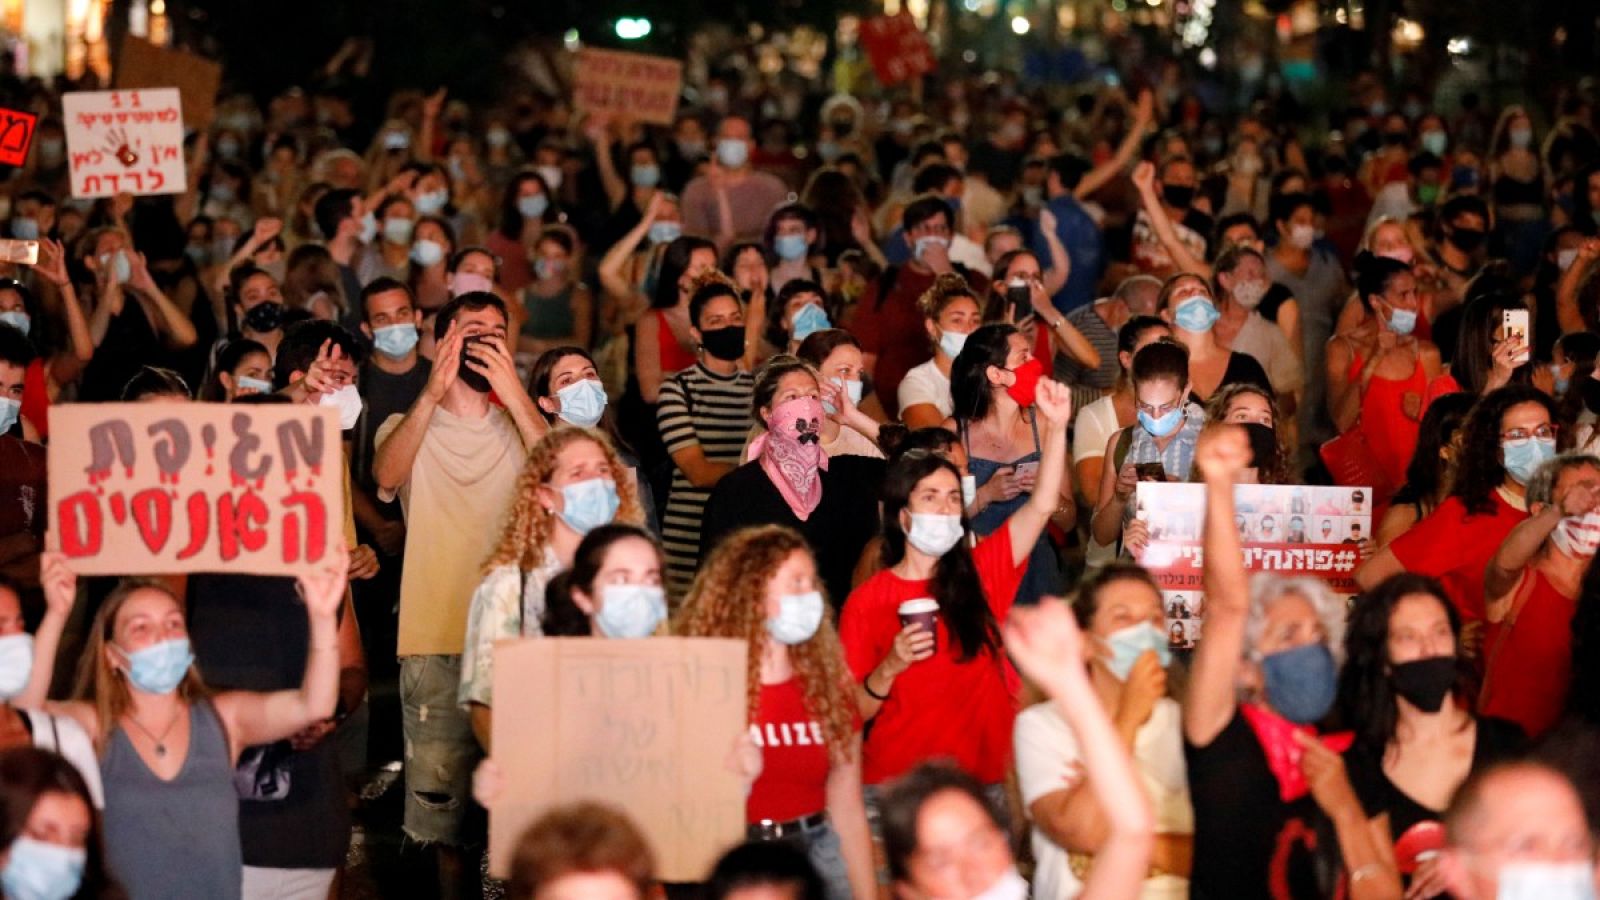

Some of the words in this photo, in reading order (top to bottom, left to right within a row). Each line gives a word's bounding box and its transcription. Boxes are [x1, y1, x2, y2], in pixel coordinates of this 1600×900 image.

[82, 169, 165, 193] לרדת
[84, 411, 324, 485] מגיפת
[58, 487, 327, 564] האנסים
[749, 722, 824, 747] ALIZE
